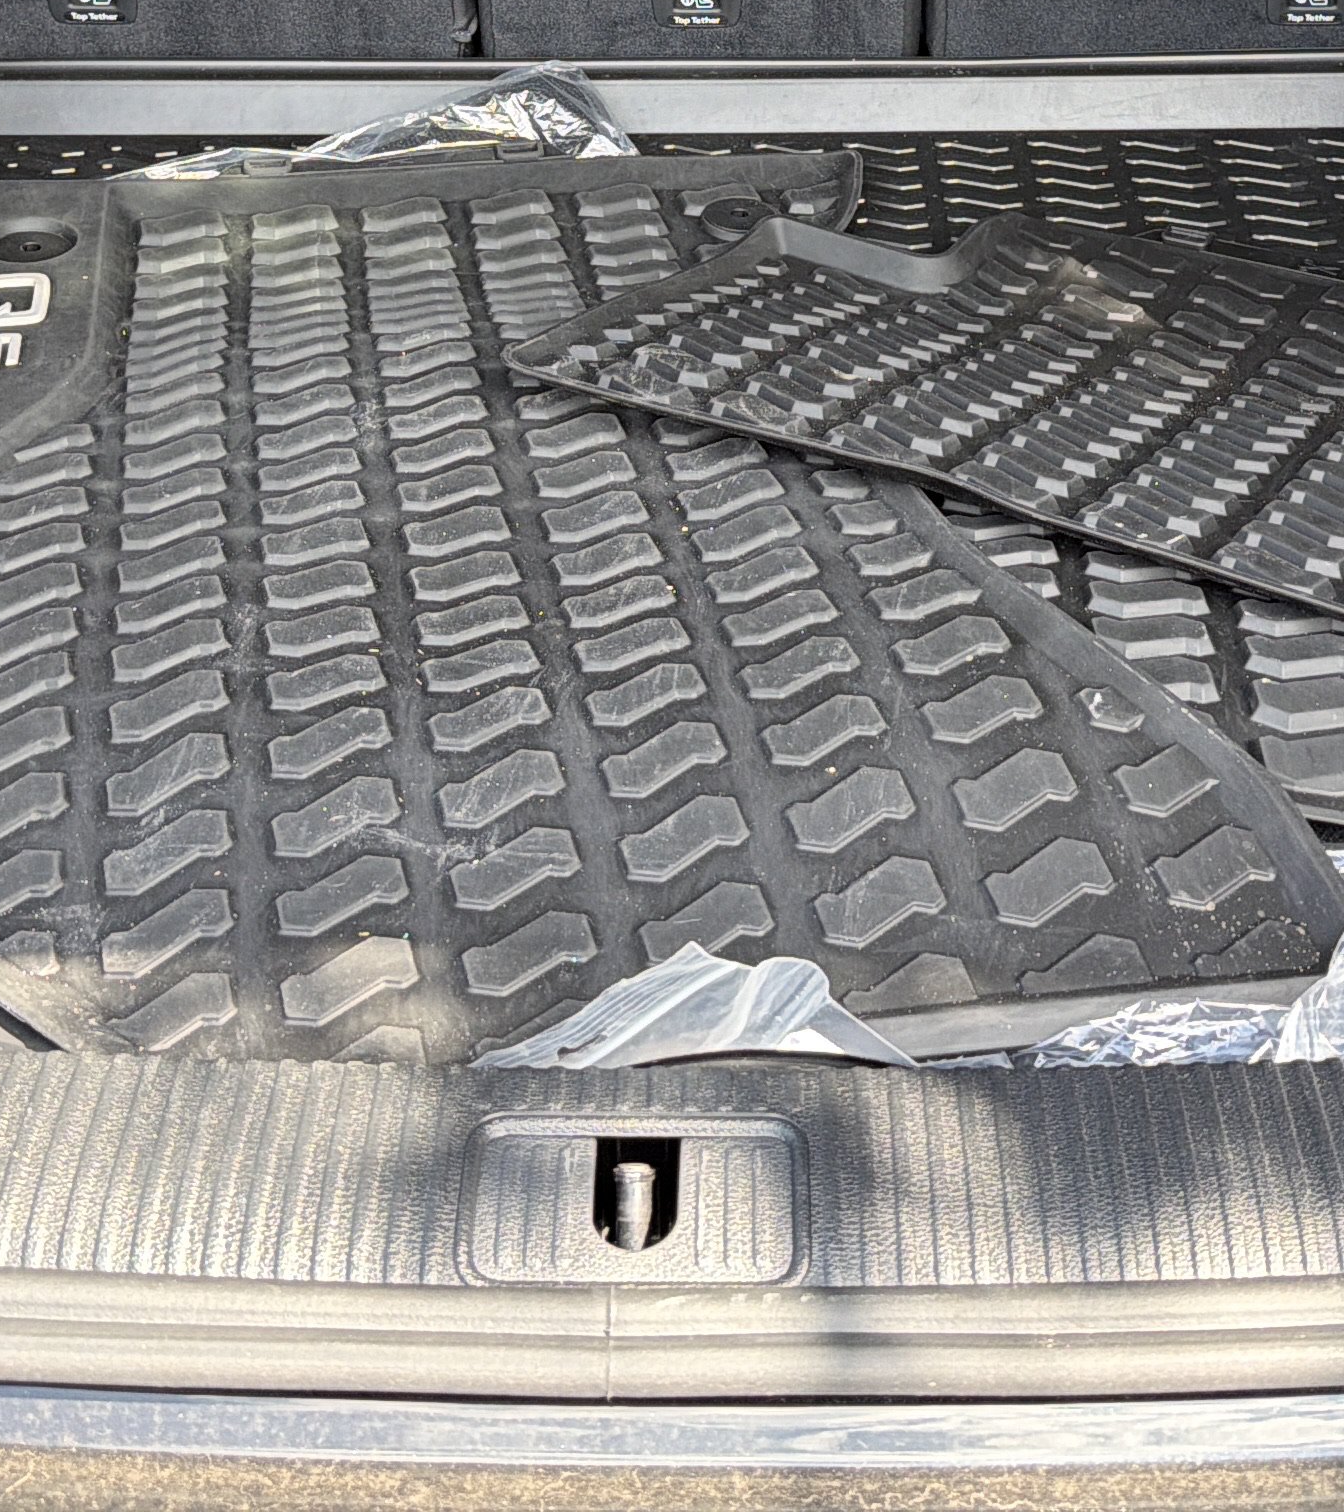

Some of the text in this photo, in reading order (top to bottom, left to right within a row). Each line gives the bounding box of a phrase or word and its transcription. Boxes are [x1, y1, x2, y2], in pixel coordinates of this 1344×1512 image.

[71, 12, 118, 21] Top Tether
[673, 16, 720, 26] Top Tether
[1287, 14, 1335, 22] Top Tether
